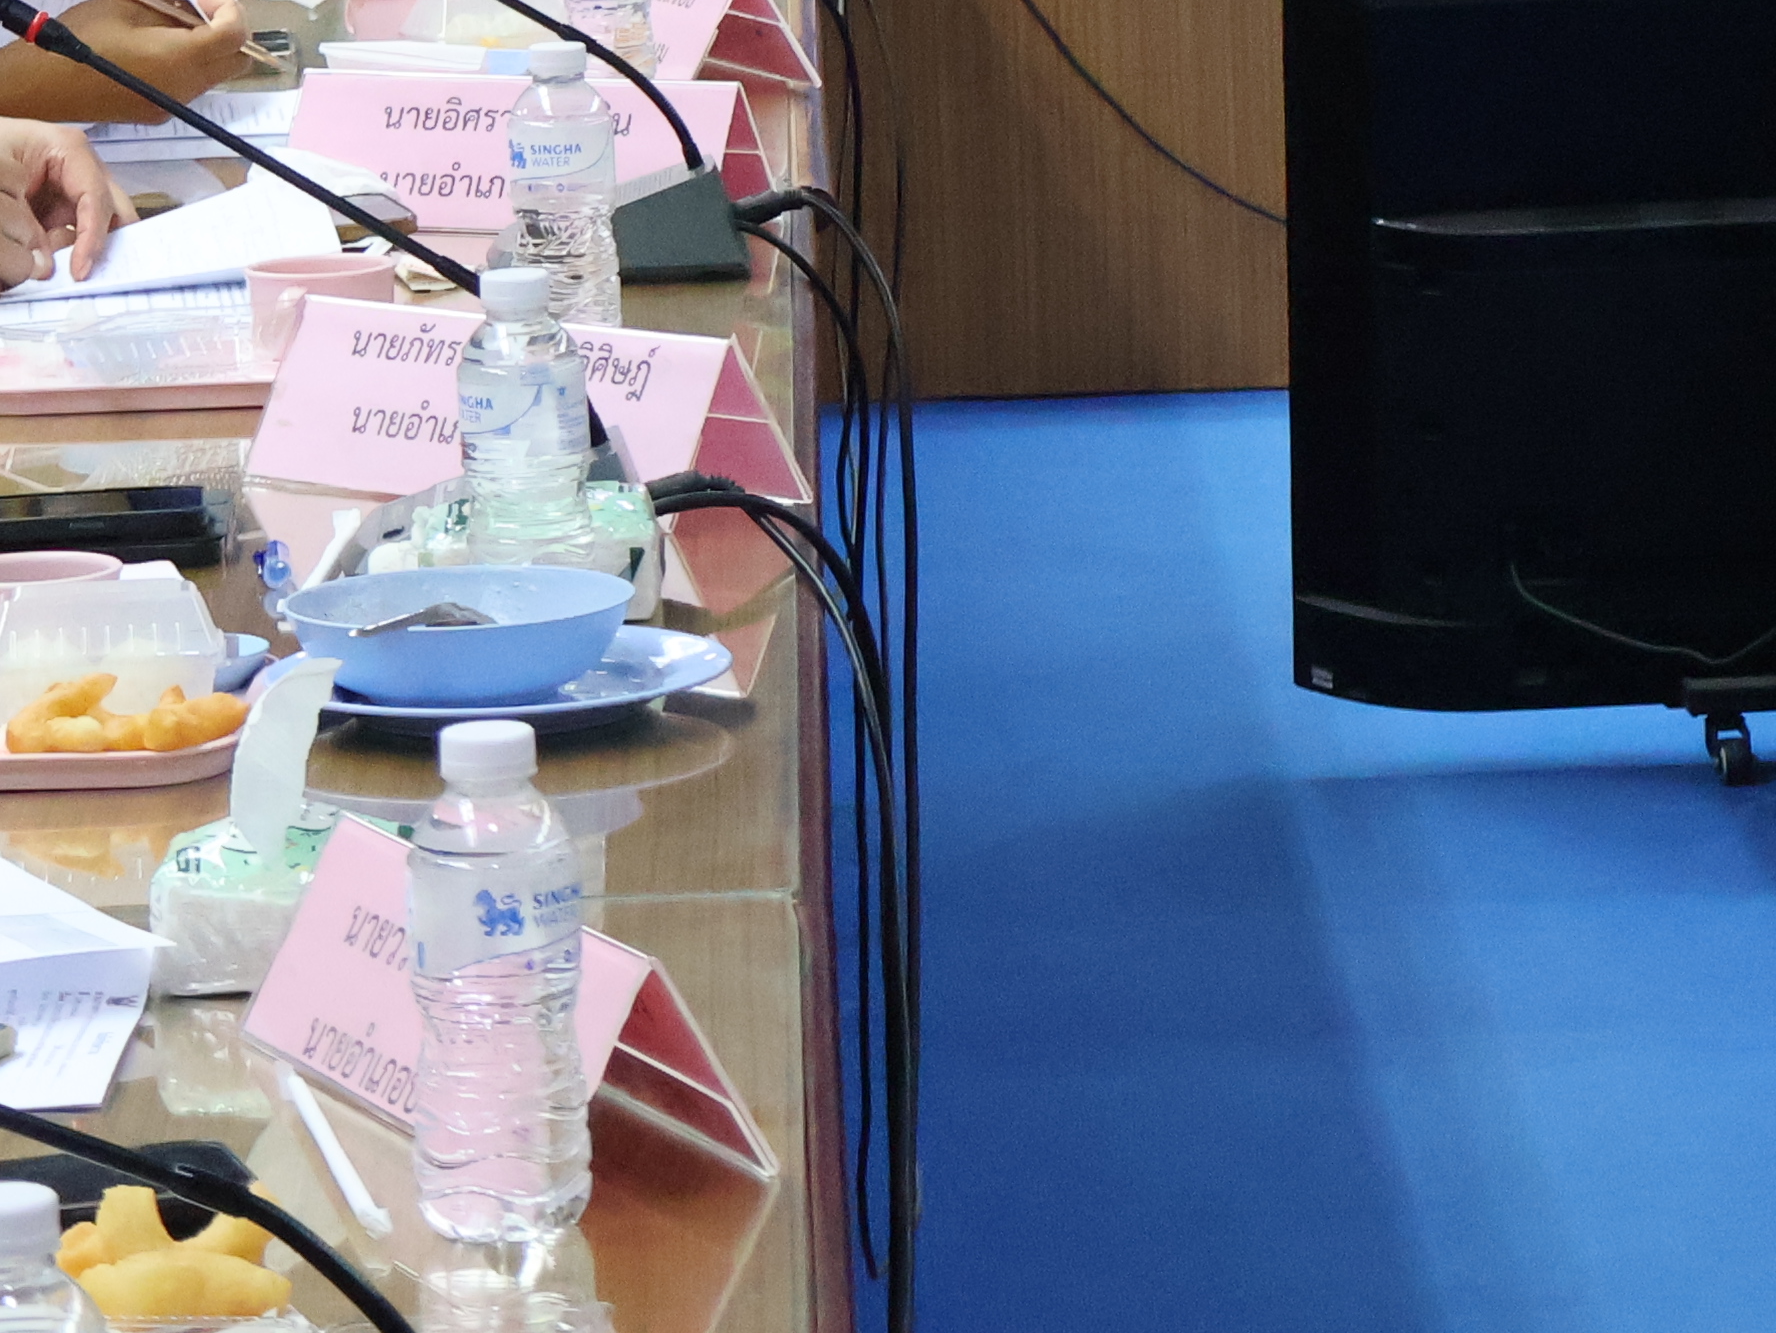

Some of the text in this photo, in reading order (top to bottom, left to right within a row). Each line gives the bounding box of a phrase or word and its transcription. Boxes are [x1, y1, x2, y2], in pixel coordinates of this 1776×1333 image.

[530, 143, 582, 156] SINGHA
[530, 156, 571, 168] WATER
[350, 400, 459, 445] นายอำเ
